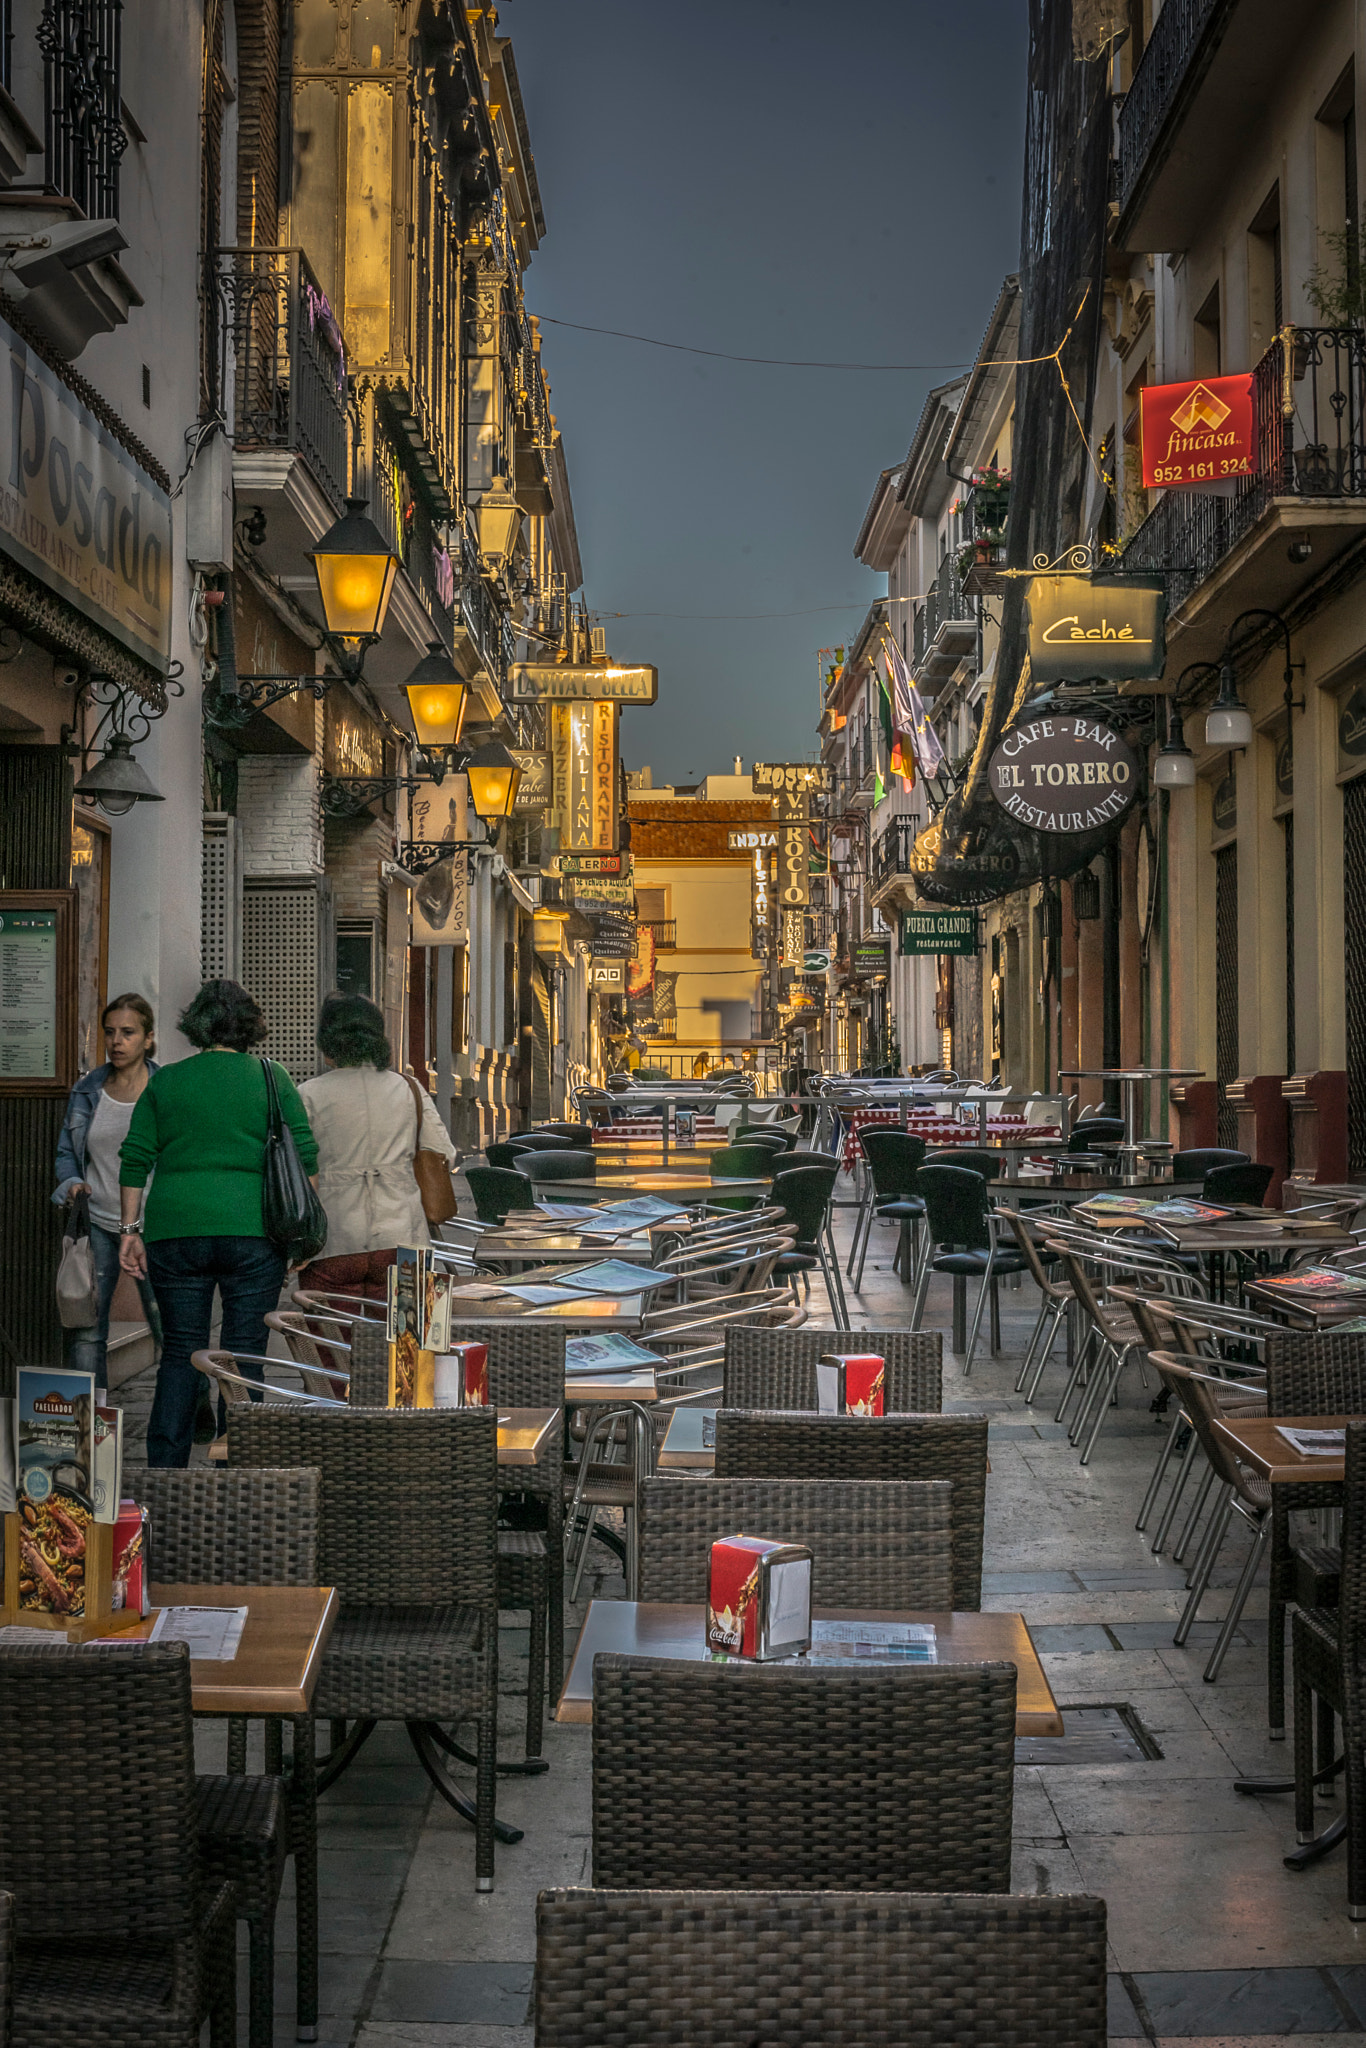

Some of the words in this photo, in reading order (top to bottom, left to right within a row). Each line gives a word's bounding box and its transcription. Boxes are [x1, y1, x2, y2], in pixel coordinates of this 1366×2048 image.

[1158, 430, 1235, 464] fincasa
[8, 352, 162, 612] Posada
[1154, 466, 1182, 483] 952
[1188, 461, 1214, 478] 161
[1220, 457, 1249, 475] 324
[1042, 616, 1152, 643] Caché
[517, 671, 536, 695] LA
[1002, 719, 1055, 757] CAFE
[1073, 718, 1117, 752] BAR
[576, 705, 591, 847] ITALIANA
[596, 704, 611, 846] RISTORANTE
[756, 767, 833, 790] HOSTAL
[996, 764, 1025, 788] EL
[1030, 761, 1130, 787] TORERO
[1003, 788, 1129, 831] RESTAURANTE
[729, 833, 778, 847] INDIA
[562, 860, 618, 870] SALERNO
[785, 827, 804, 903] ROCIO
[599, 930, 630, 938] Quino
[906, 917, 936, 934] PUERTA
[937, 917, 971, 934] GRANDE
[916, 939, 961, 948] restaurante
[35, 1402, 73, 1414] PAELLADOR
